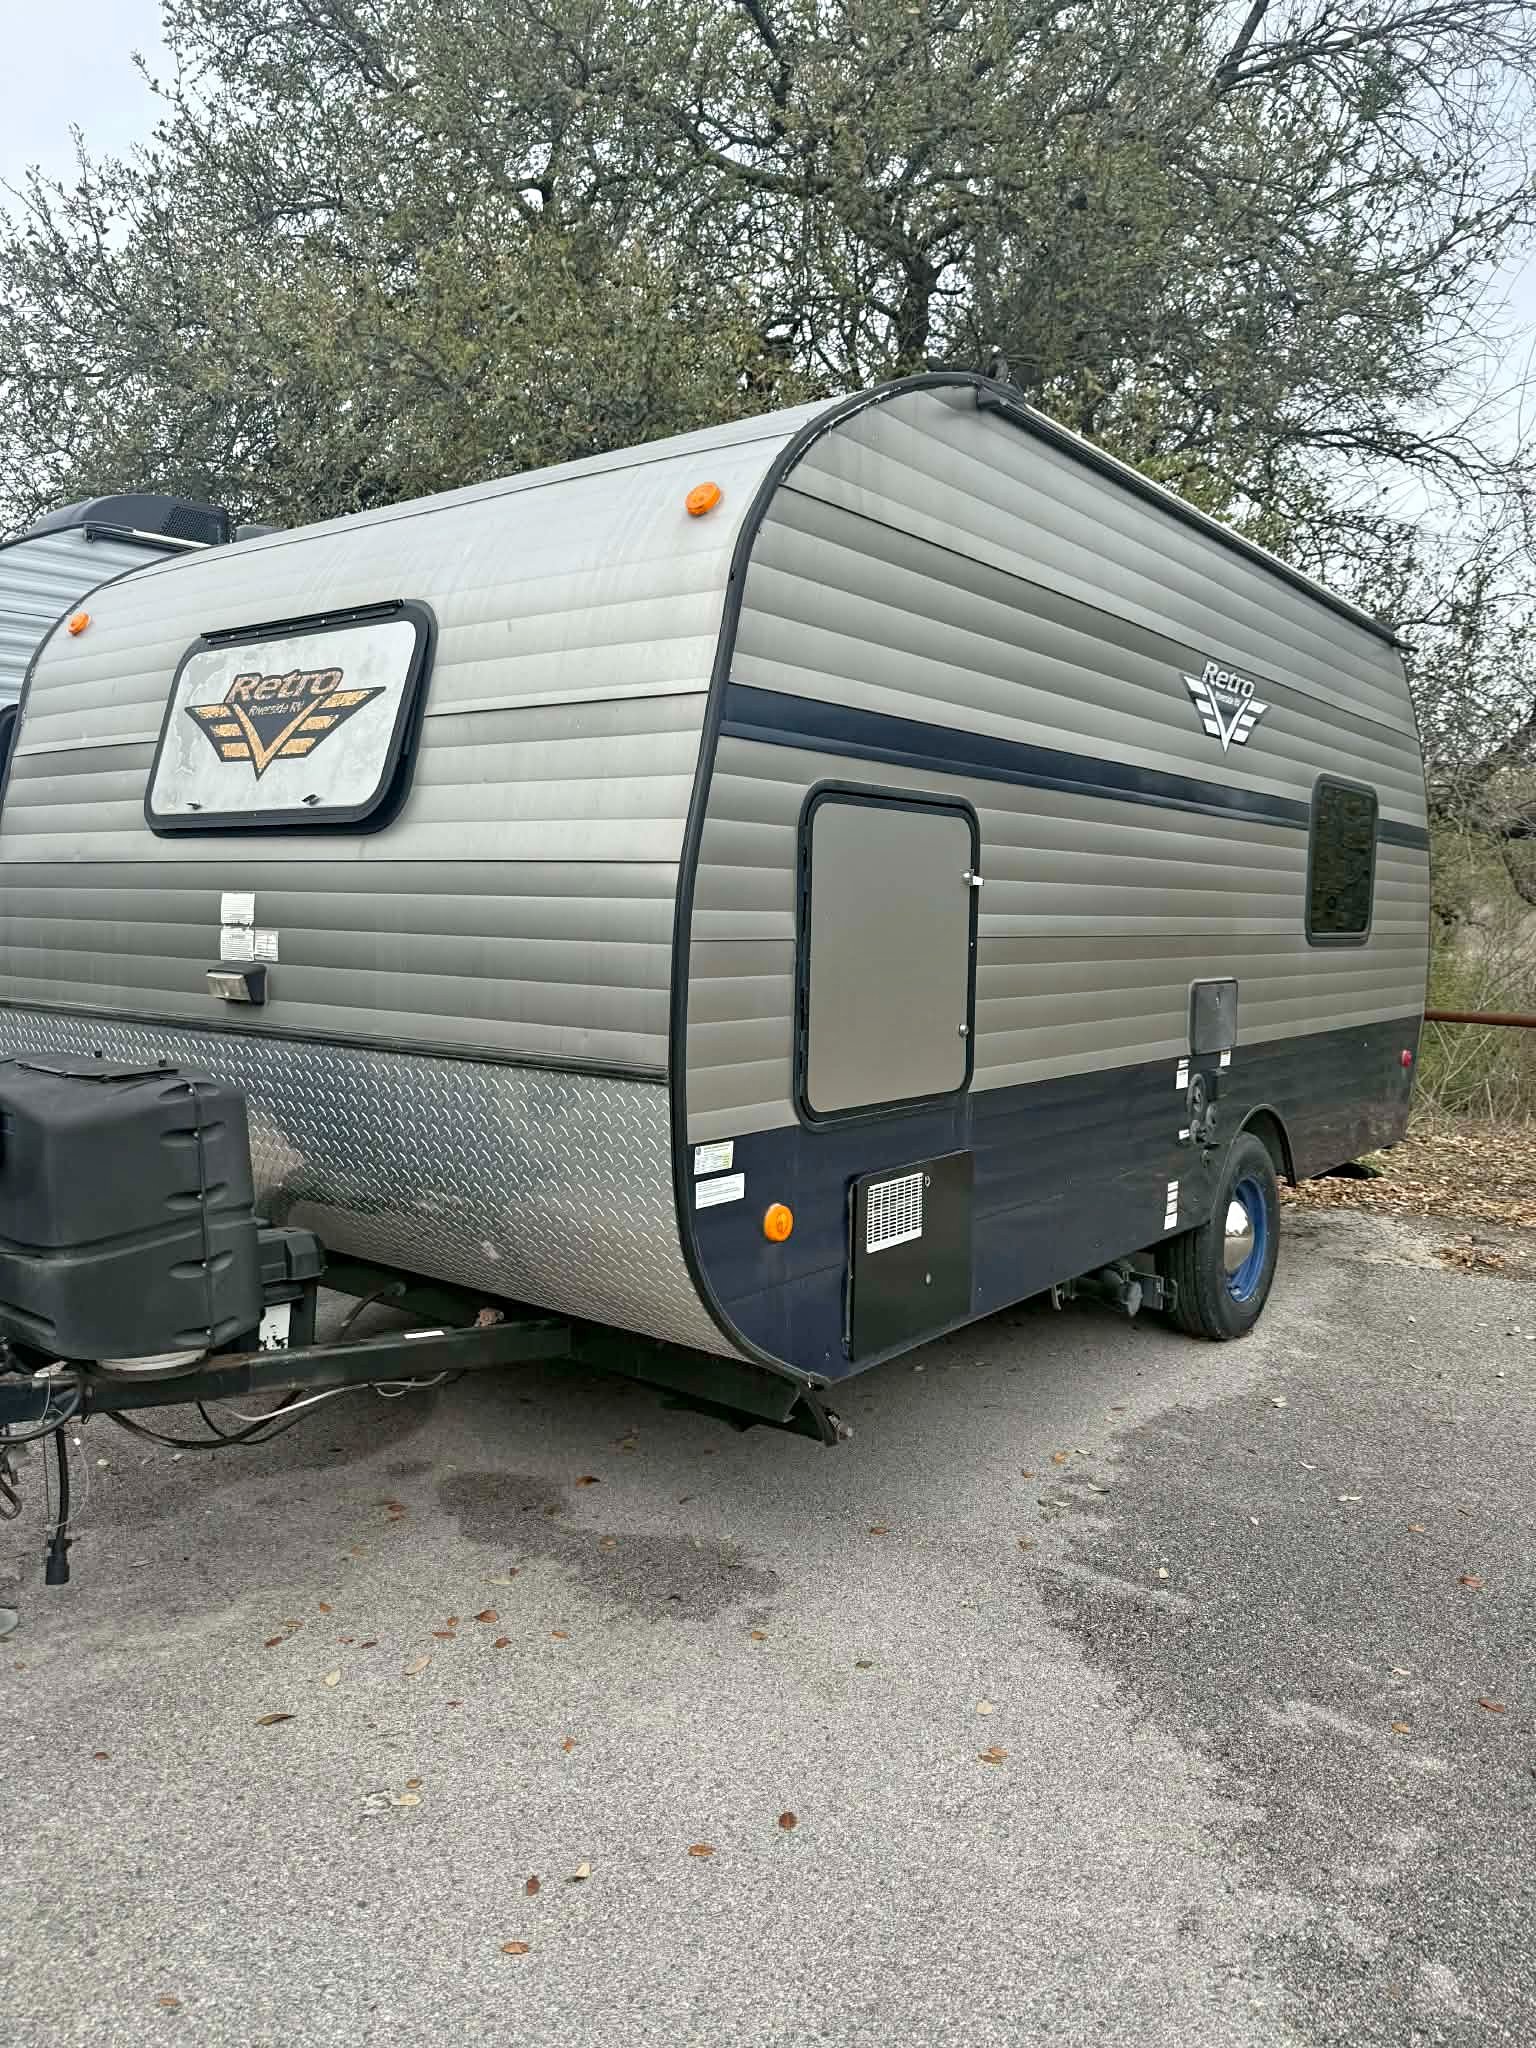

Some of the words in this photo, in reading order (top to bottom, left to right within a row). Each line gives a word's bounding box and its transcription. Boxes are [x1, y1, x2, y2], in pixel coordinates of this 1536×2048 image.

[224, 669, 342, 704] Retro
[1202, 660, 1255, 698] Retro
[248, 703, 289, 717] Riverside
[289, 700, 305, 713] RV
